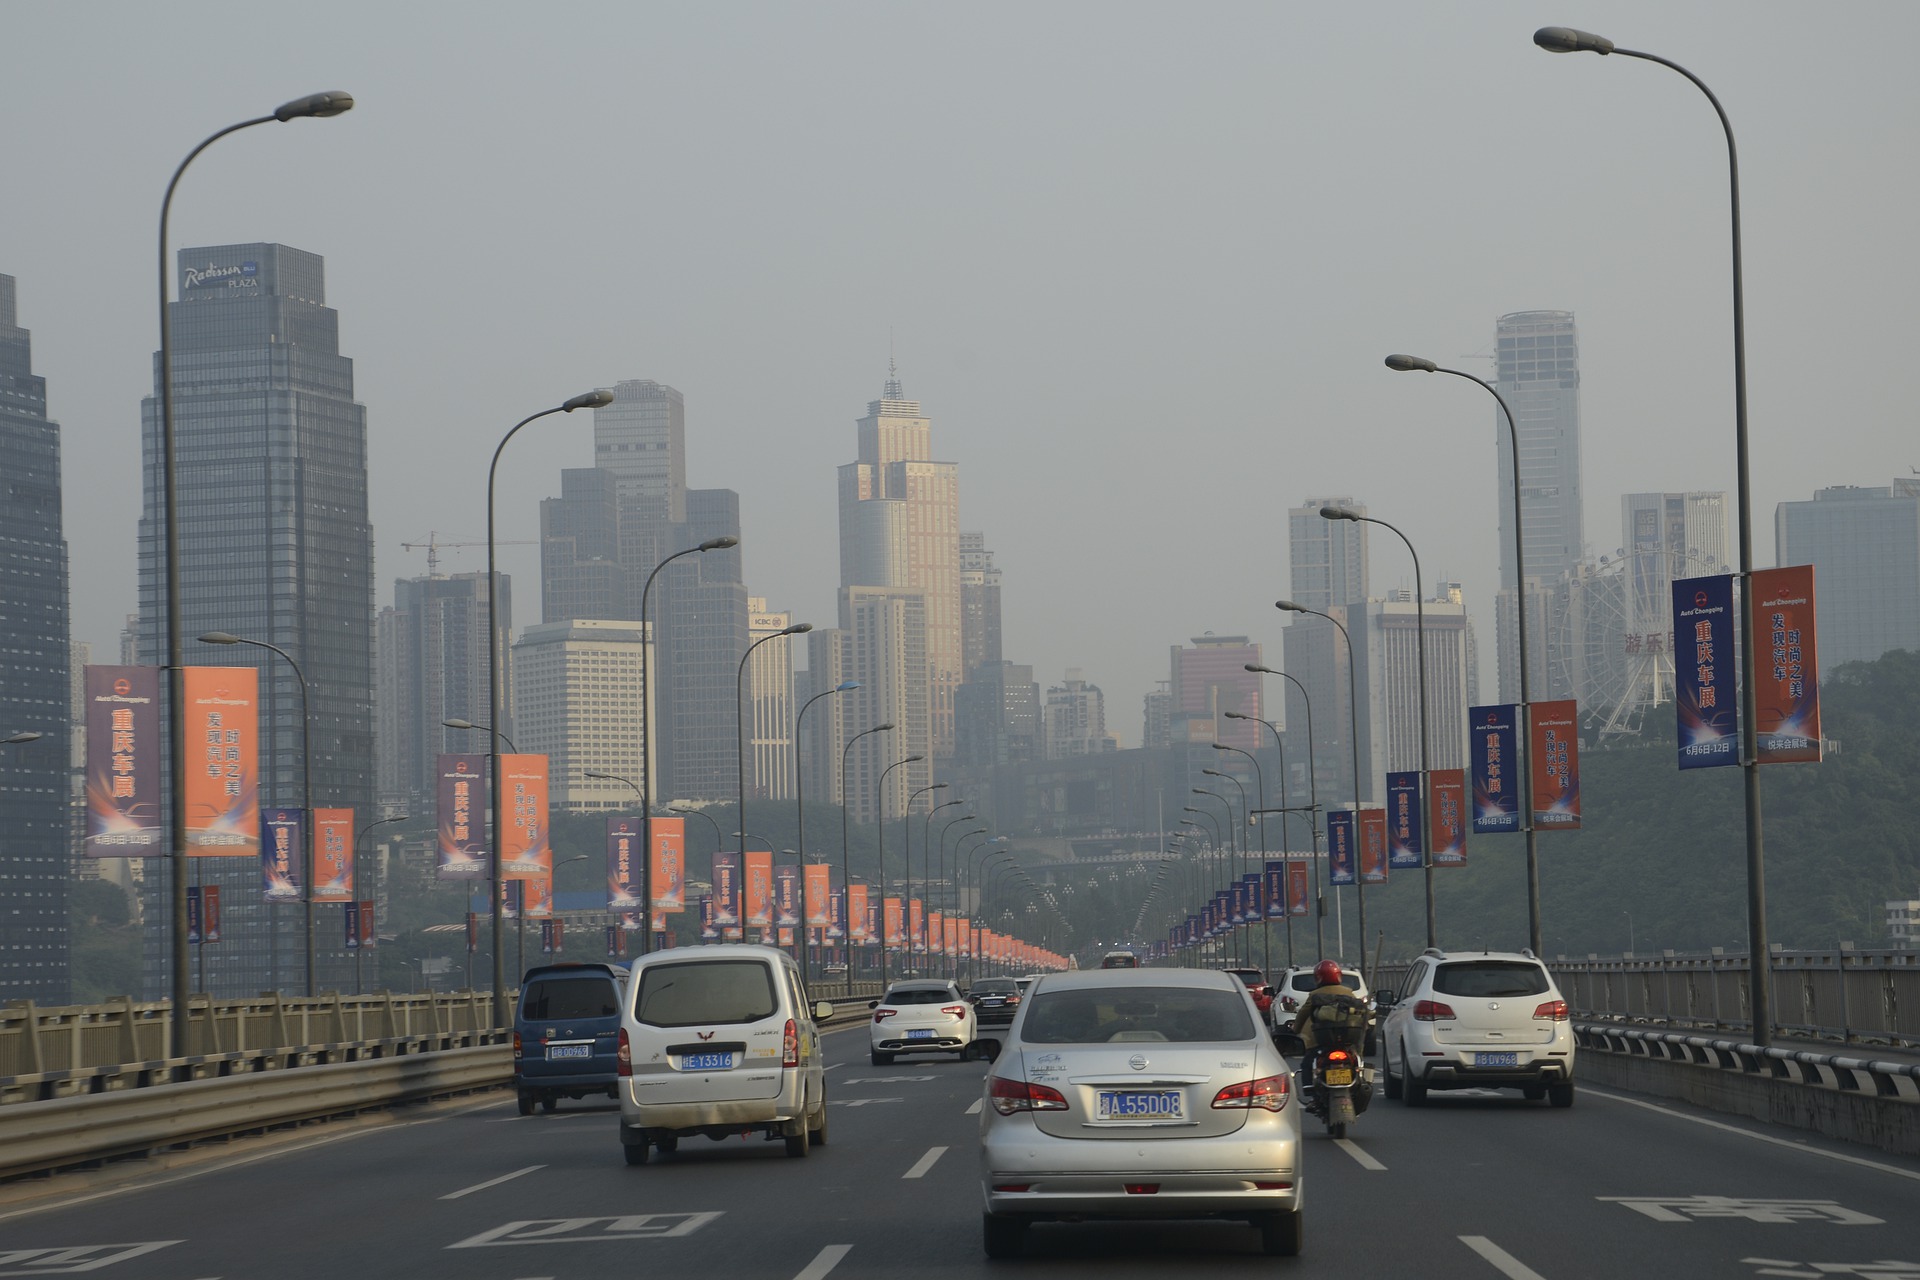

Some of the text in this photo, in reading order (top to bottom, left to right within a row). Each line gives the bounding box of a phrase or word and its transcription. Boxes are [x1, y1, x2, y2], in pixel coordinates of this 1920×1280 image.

[184, 262, 242, 289] Radisson
[228, 279, 258, 288] PLAZA
[1680, 605, 1724, 617] Auto Chongqing
[1762, 596, 1807, 607] Auto Chongqing
[1695, 620, 1716, 708] 重庆车展
[1771, 613, 1787, 681] 发现汽车
[1788, 630, 1803, 698] 时尚之美
[111, 708, 136, 798] 重庆车展
[206, 712, 223, 779] 发现汽车
[224, 729, 241, 796] 时尚之美
[1486, 733, 1502, 793] 重庆车展
[1545, 730, 1557, 776] 发现汽车
[1557, 742, 1569, 788] 时尚之美
[1686, 743, 1730, 756] 6月6日-12日
[454, 781, 470, 841] 重庆车展
